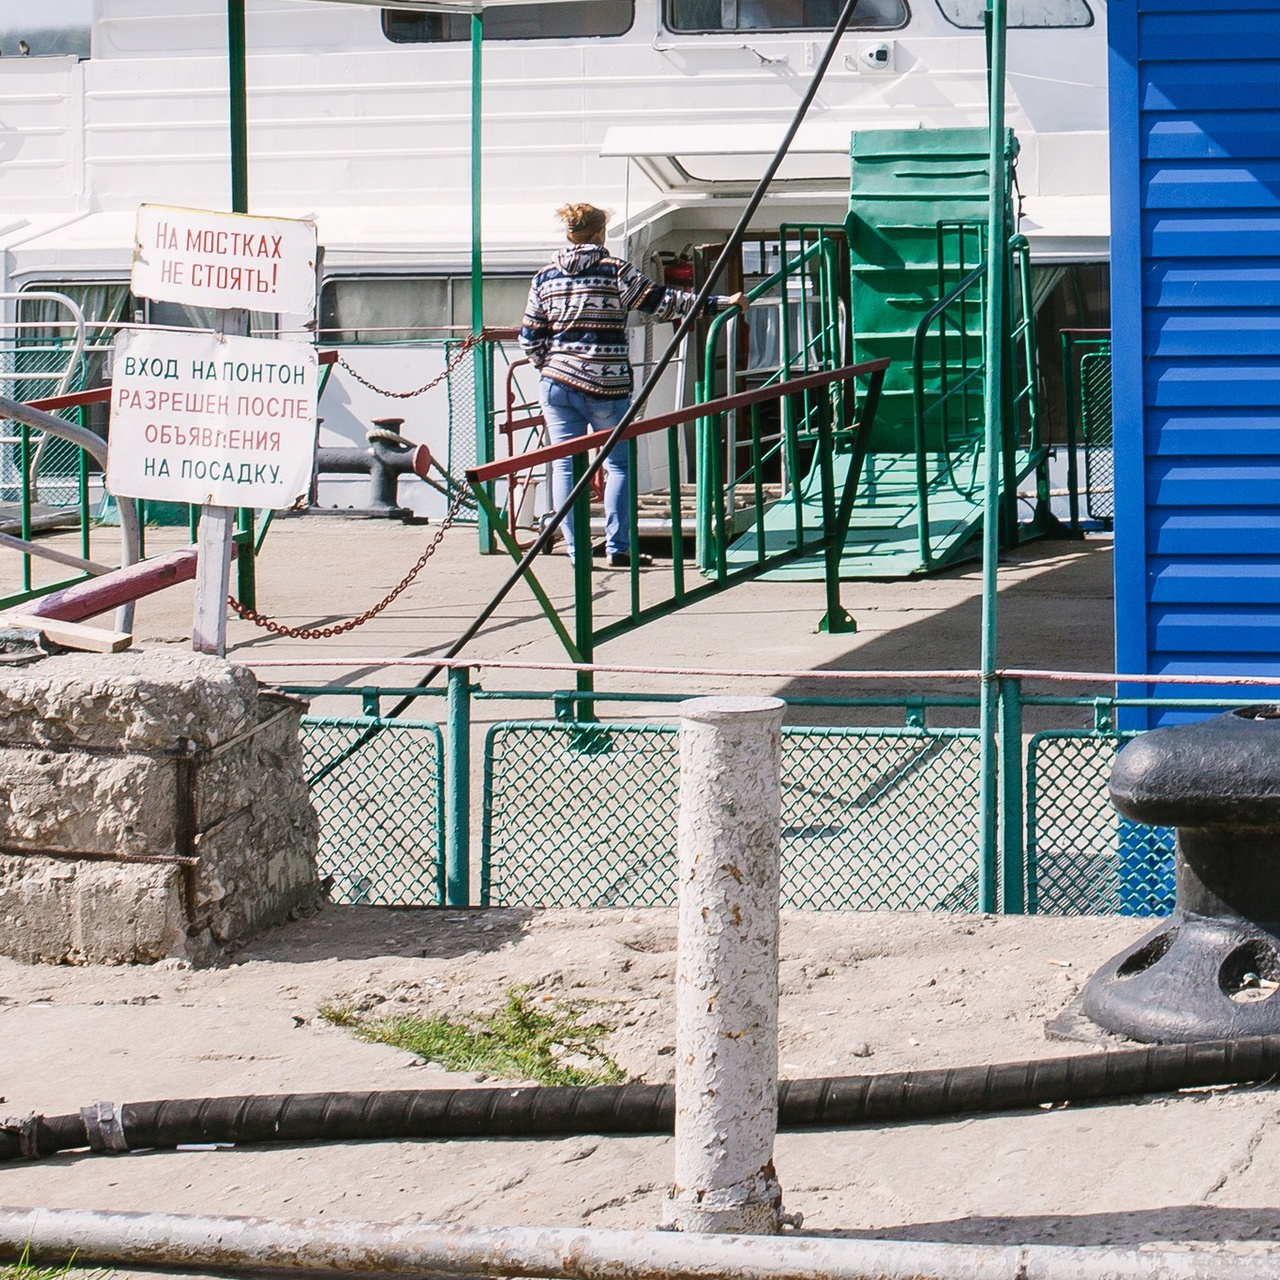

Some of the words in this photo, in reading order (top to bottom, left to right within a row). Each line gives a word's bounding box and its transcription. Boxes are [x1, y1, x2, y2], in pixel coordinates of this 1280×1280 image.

[186, 228, 282, 259] МОСТКАХ
[161, 260, 184, 285] НЕ
[191, 263, 277, 294] СТОЯТЬ!
[125, 357, 179, 380] ВХОД
[118, 389, 229, 416] РАЗРЕШЕН
[237, 396, 309, 420] ПОСЛЕ
[145, 424, 281, 452] ОБЪЯВЛЕНИЯ
[144, 457, 171, 478] НА
[181, 459, 283, 485] ПОСАДКУ.
